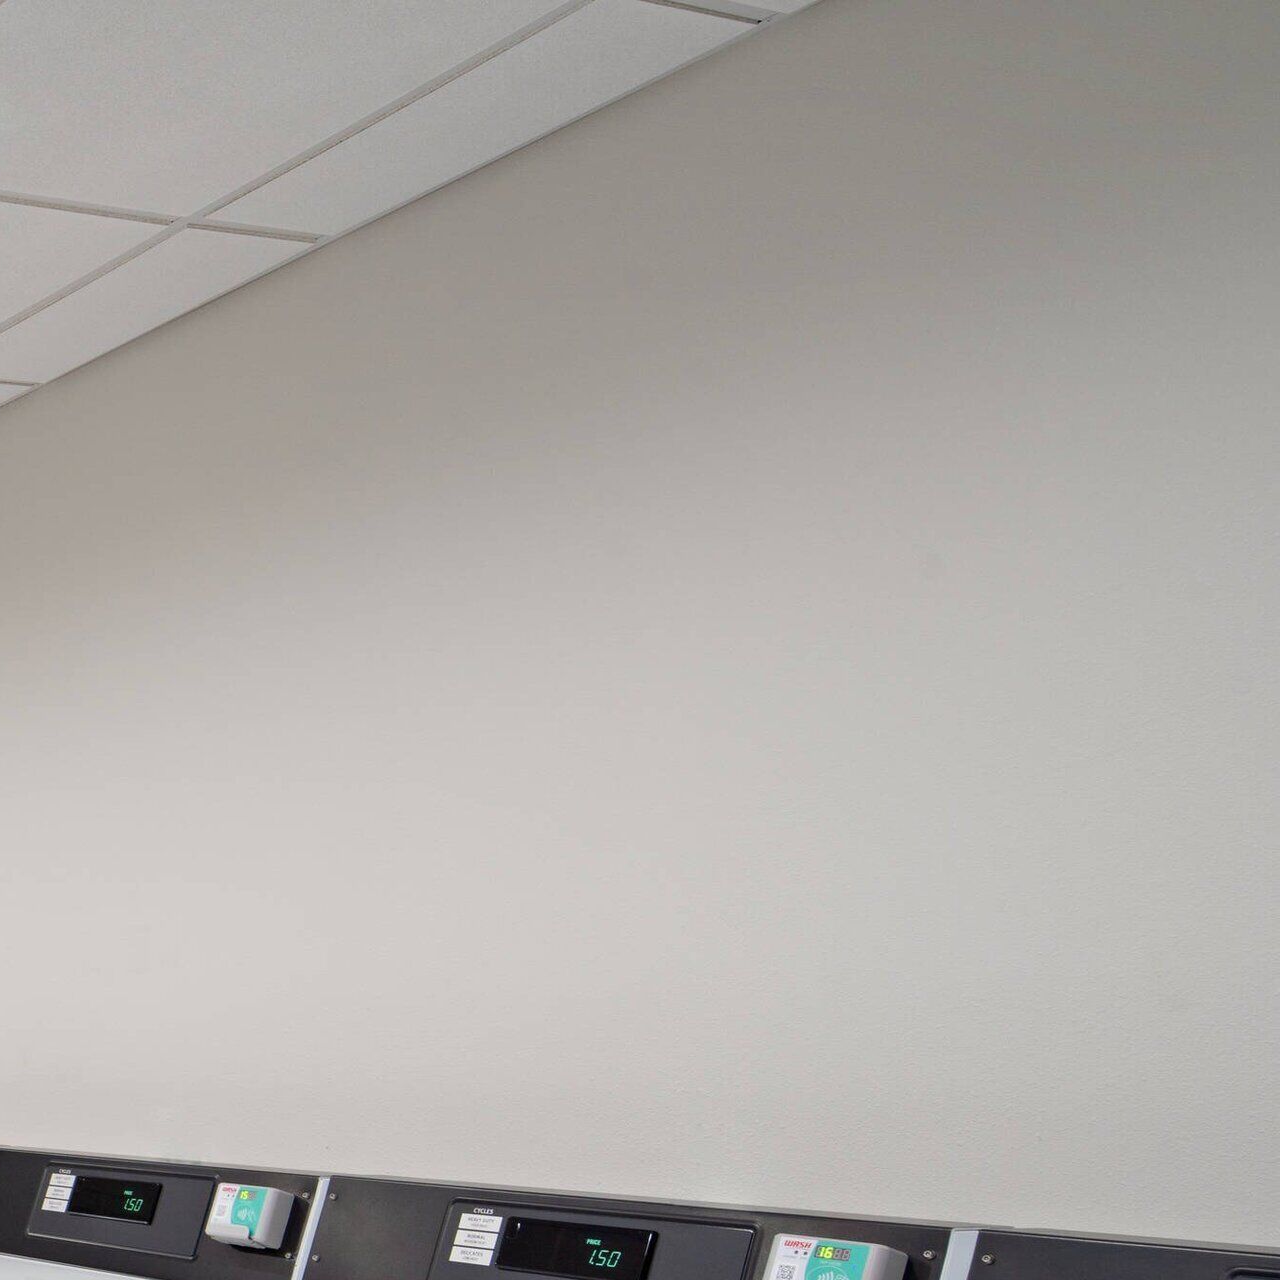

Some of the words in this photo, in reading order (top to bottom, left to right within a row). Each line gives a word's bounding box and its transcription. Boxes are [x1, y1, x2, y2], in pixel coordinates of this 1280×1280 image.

[473, 1207, 494, 1215] CYCLES
[784, 1240, 812, 1248] WASH
[820, 1247, 833, 1258] 16
[589, 1249, 621, 1267] 1.50
